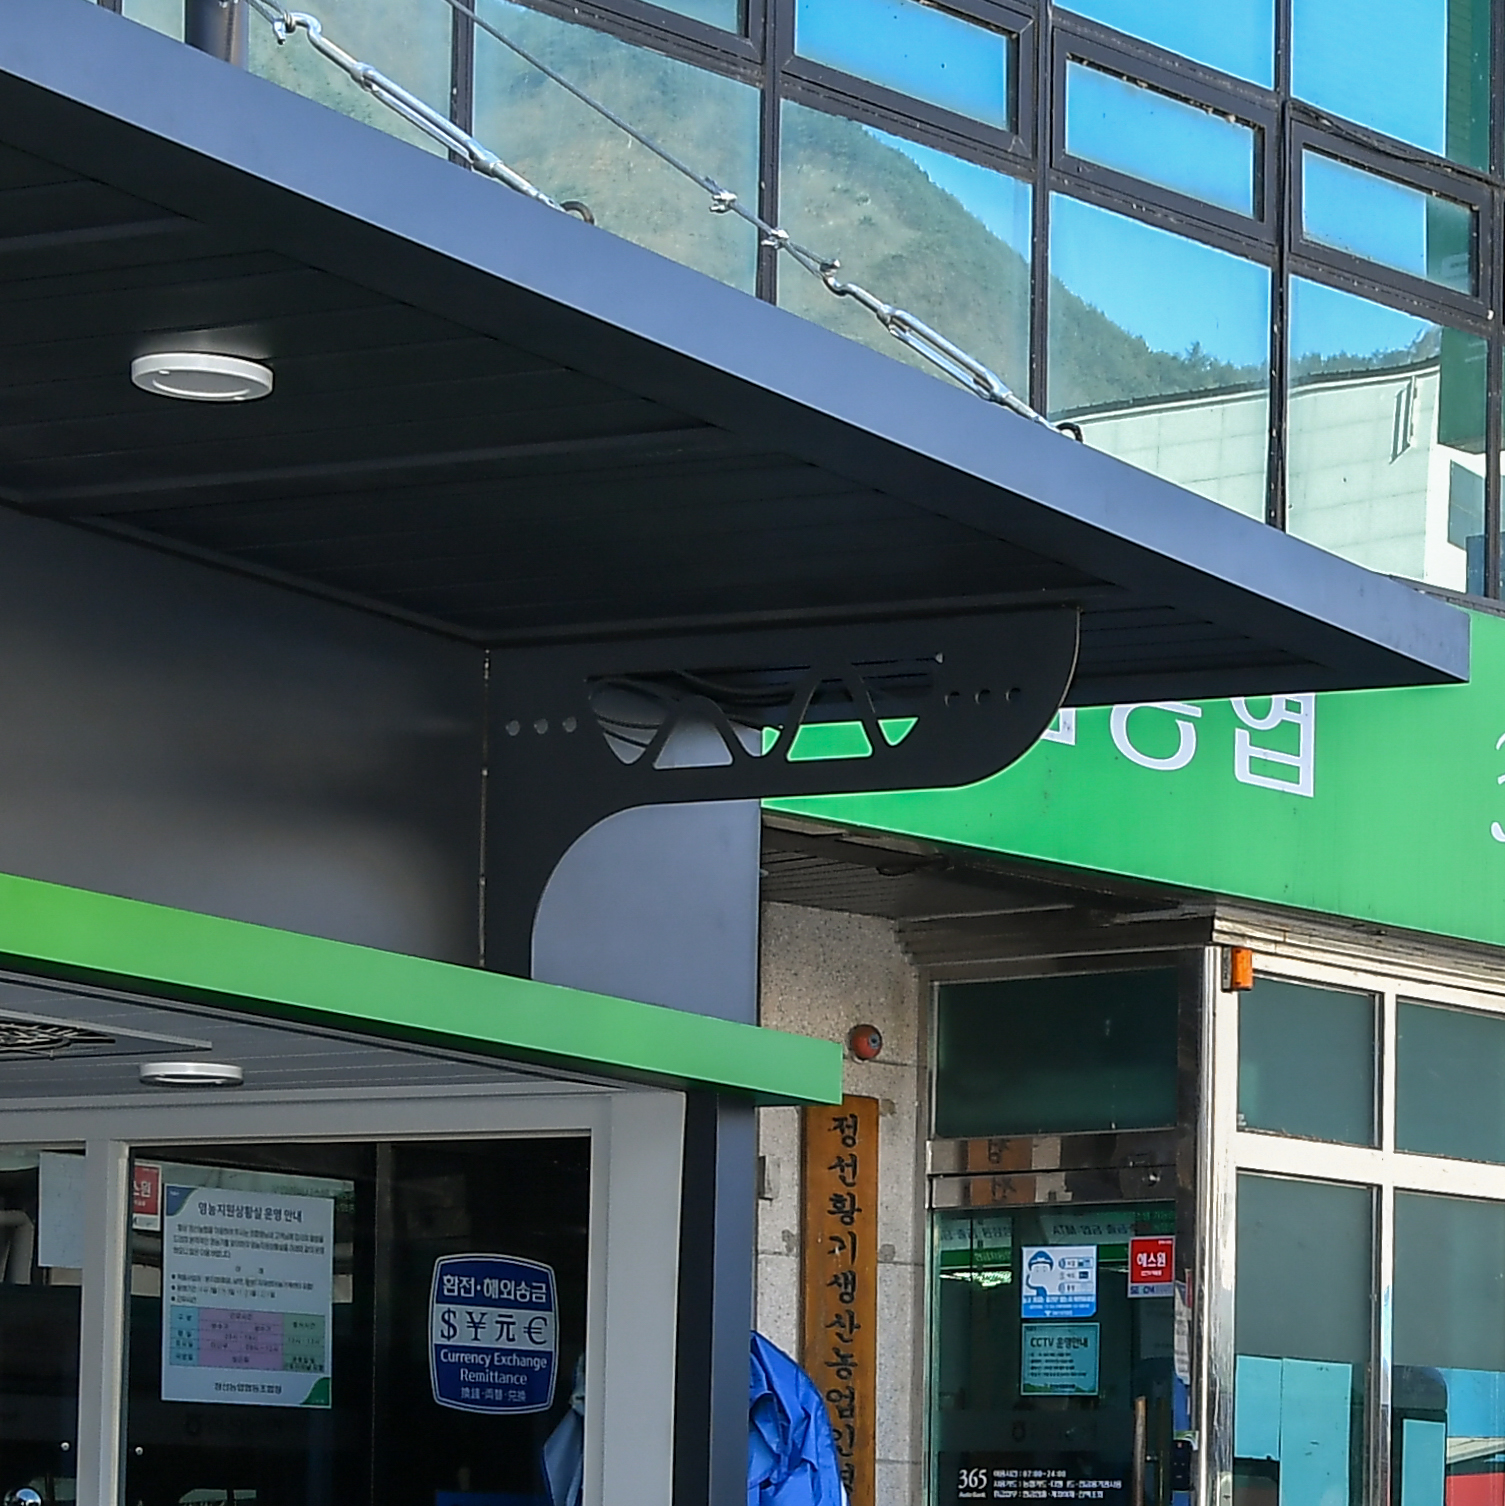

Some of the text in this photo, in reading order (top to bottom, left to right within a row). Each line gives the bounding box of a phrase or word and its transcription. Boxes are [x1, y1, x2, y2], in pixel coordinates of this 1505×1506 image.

[1136, 1252, 1166, 1268] 에스원
[442, 1274, 547, 1303] 환전·해외송금
[1030, 1337, 1054, 1348] CCTV
[440, 1349, 548, 1371] Currency Exchange
[460, 1368, 528, 1385] Remittance
[958, 1468, 987, 1489] 365
